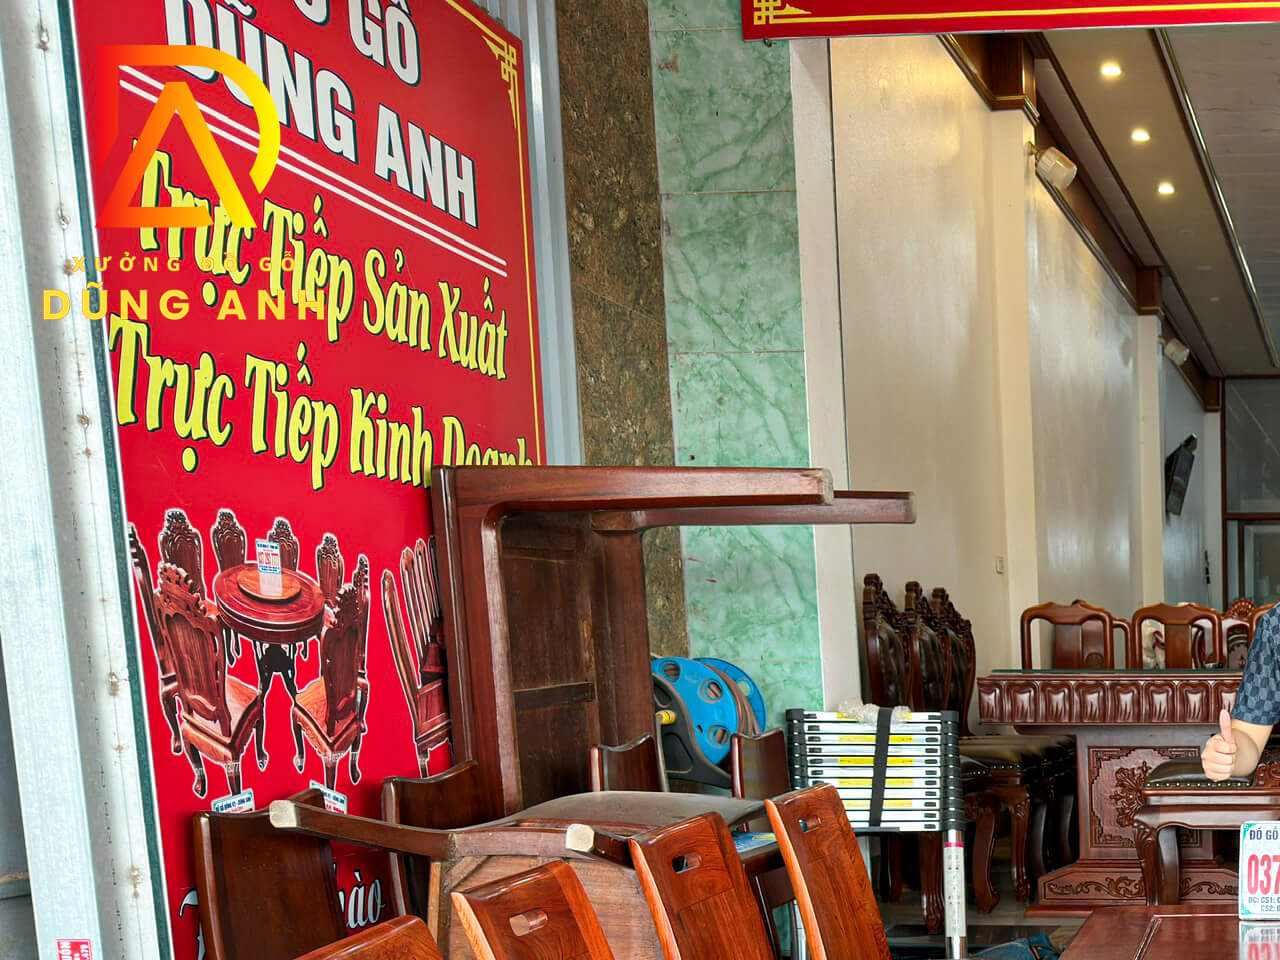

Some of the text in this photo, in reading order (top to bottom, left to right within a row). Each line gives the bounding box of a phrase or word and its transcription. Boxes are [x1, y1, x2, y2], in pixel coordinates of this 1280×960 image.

[374, 103, 478, 228] ANH
[263, 193, 354, 343] Tiếp
[363, 248, 431, 353] Sản
[438, 276, 509, 380] Xuất
[109, 312, 434, 491] Trực Tiếp Kinh
